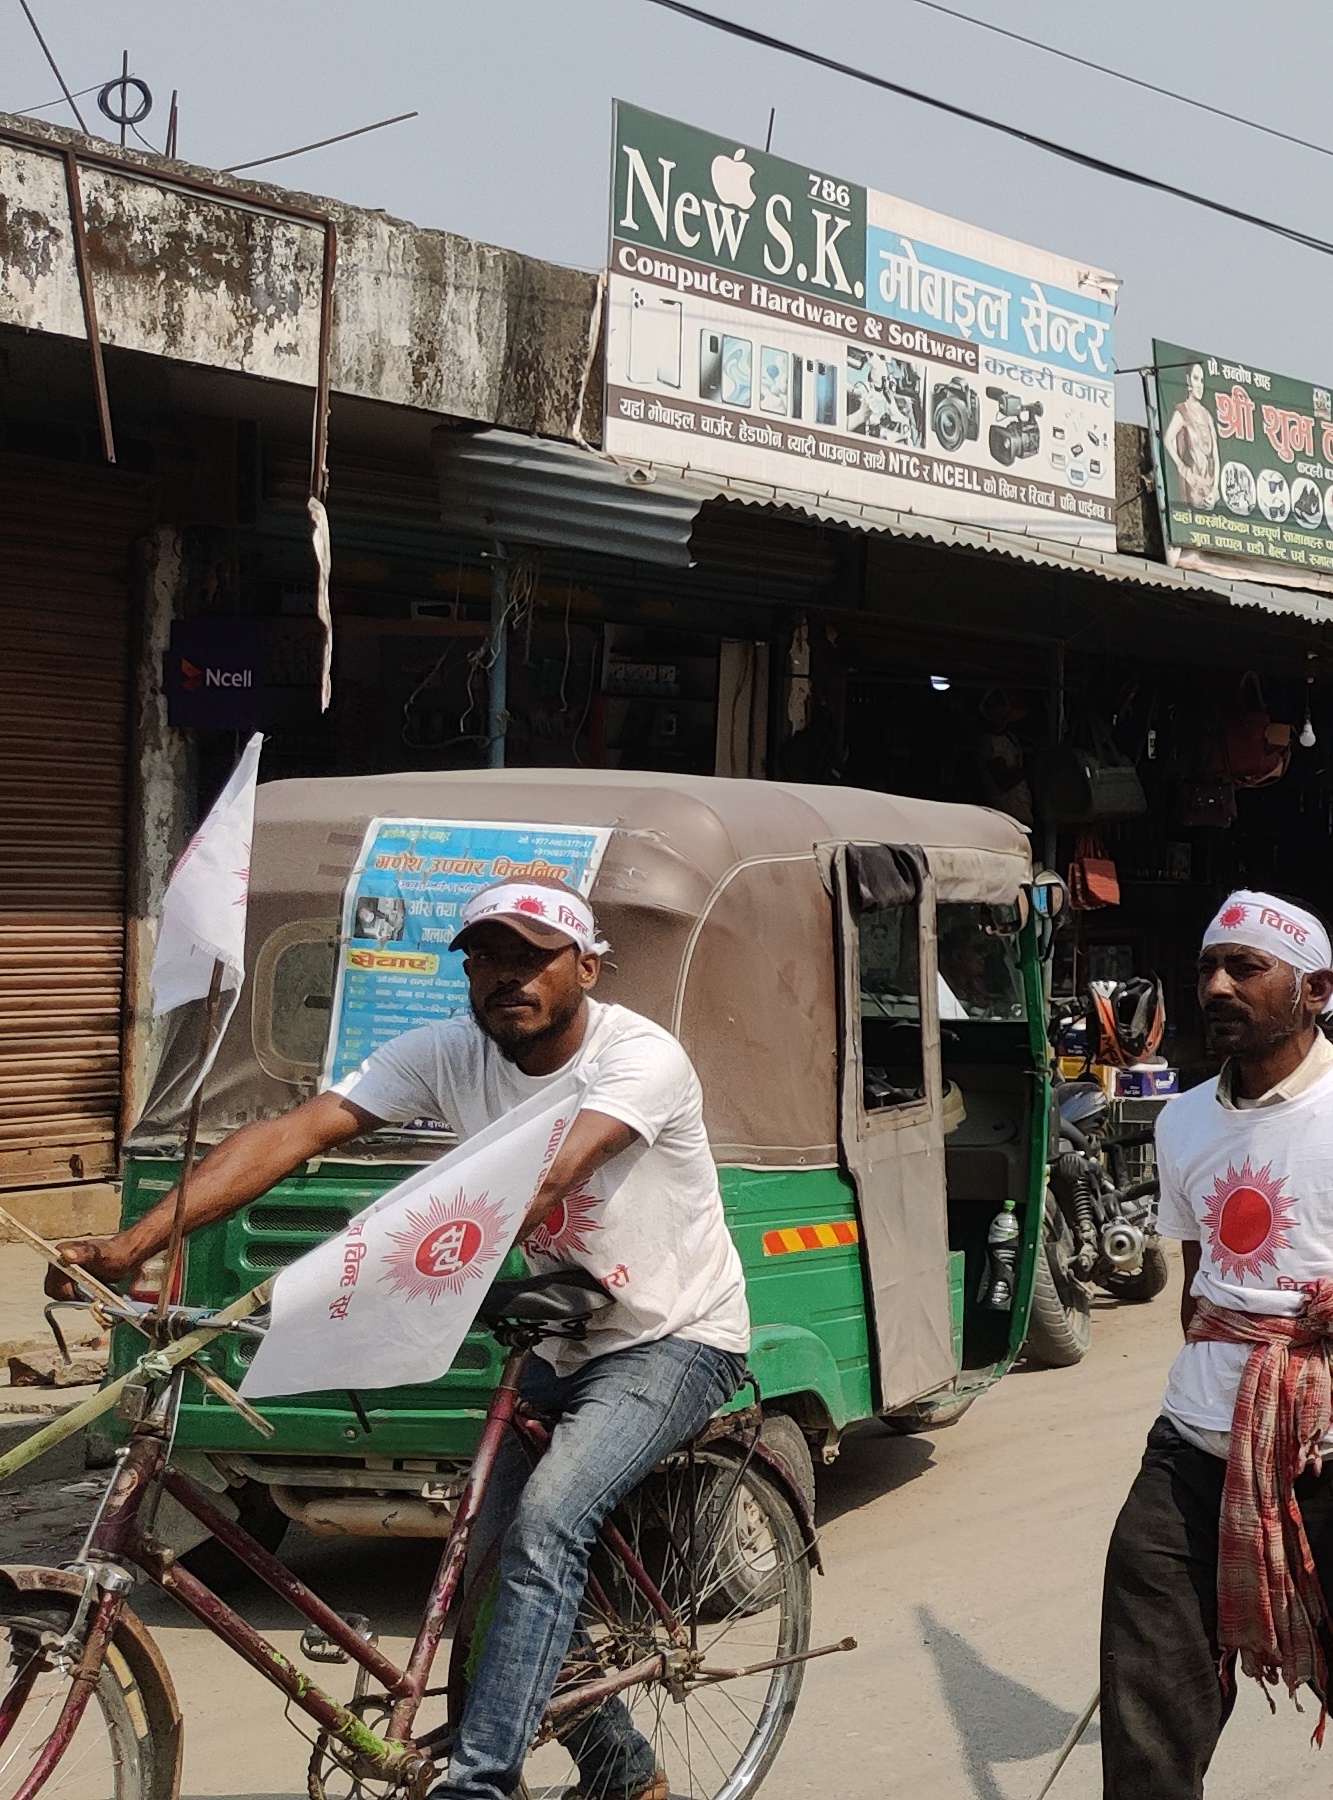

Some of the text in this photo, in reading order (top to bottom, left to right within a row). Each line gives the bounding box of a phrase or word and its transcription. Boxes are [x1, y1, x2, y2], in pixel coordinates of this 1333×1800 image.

[808, 174, 850, 207] 786
[620, 144, 865, 299] New S.K.
[618, 246, 977, 366] Computer Hardware & Software
[880, 238, 1110, 373] मोबाइल सेन्टर
[984, 356, 1112, 408] कटहरी बजार
[1214, 384, 1255, 443] श्री
[889, 451, 920, 478] NTC
[932, 461, 982, 491] NCELL
[205, 668, 252, 688] Ncell
[374, 852, 426, 872] गणेश
[428, 858, 491, 877] उपचार
[1260, 908, 1311, 946] चिन्ह
[340, 1244, 367, 1288] चिन्ह
